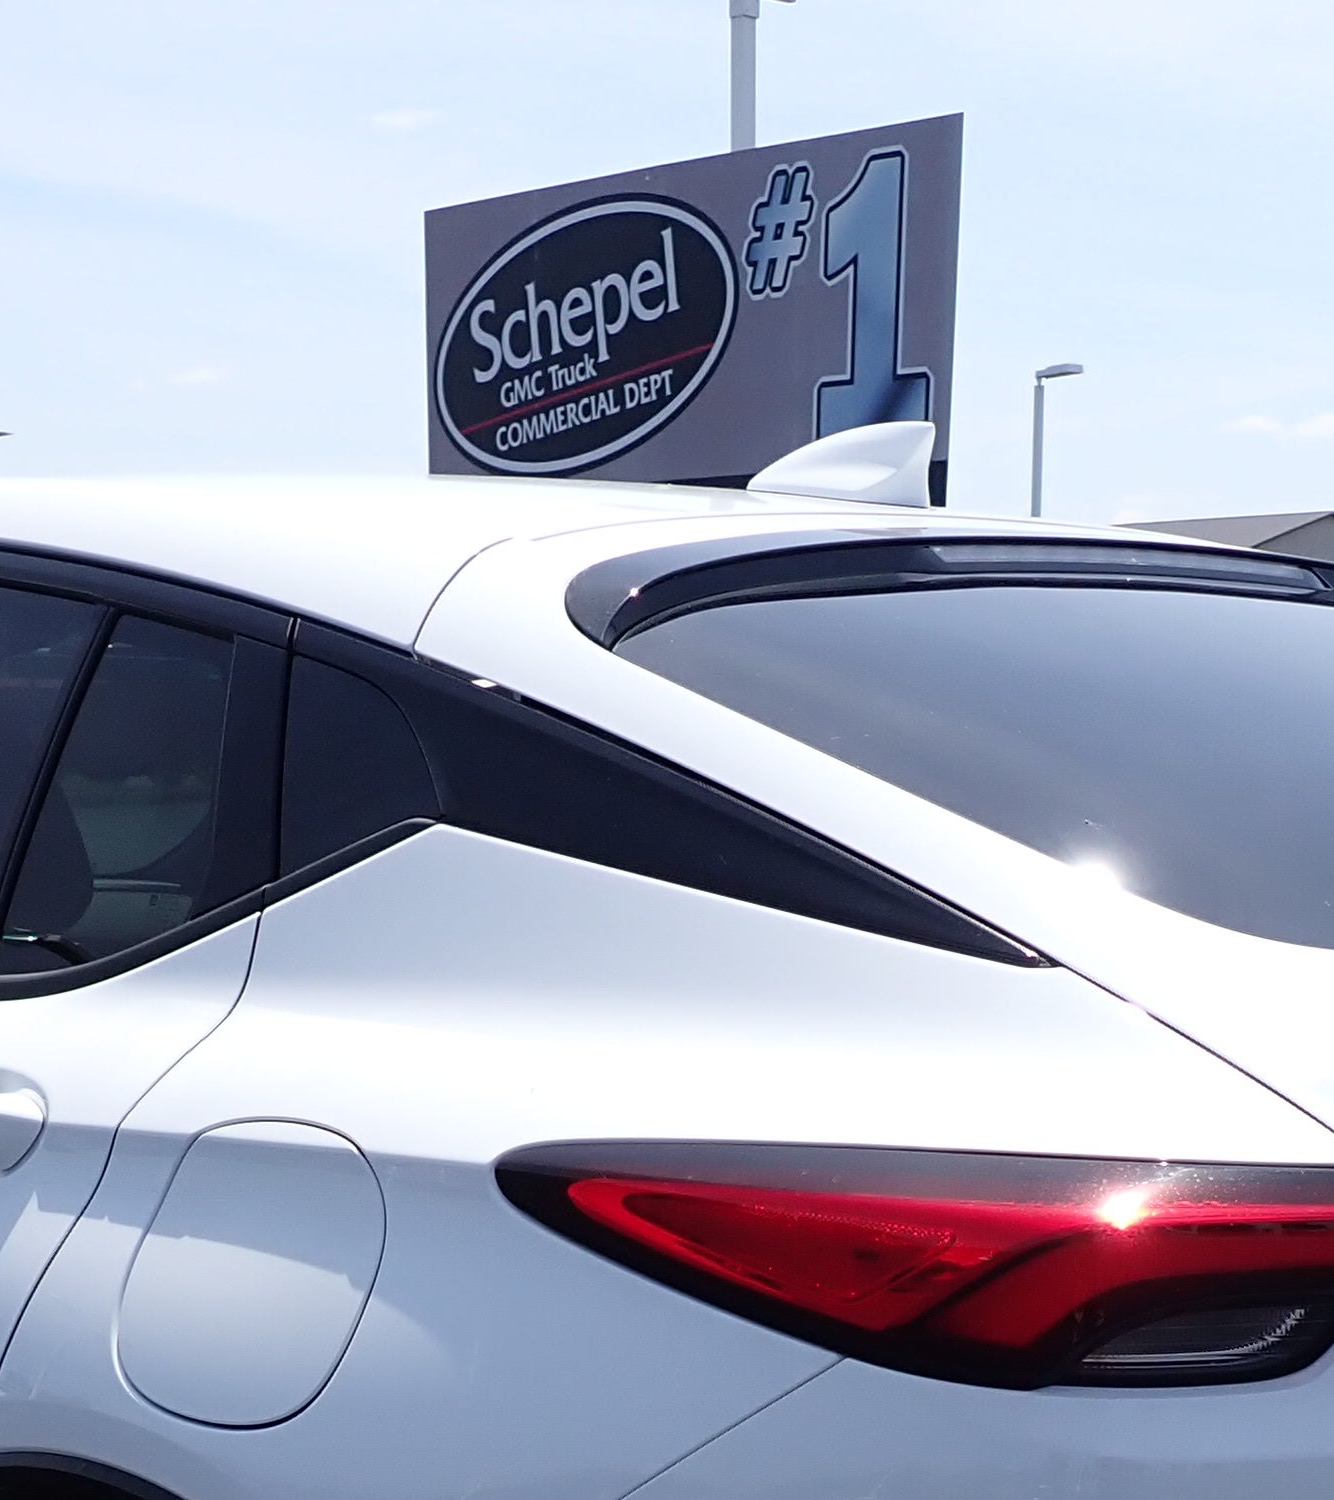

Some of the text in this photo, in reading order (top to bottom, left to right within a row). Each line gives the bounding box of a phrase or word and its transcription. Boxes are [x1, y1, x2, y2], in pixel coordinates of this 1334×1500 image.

[469, 227, 681, 384] Schepel
[743, 145, 933, 442] #1
[495, 368, 674, 451] COMMERCIAL DEPT
[500, 353, 598, 408] GMC Truck
